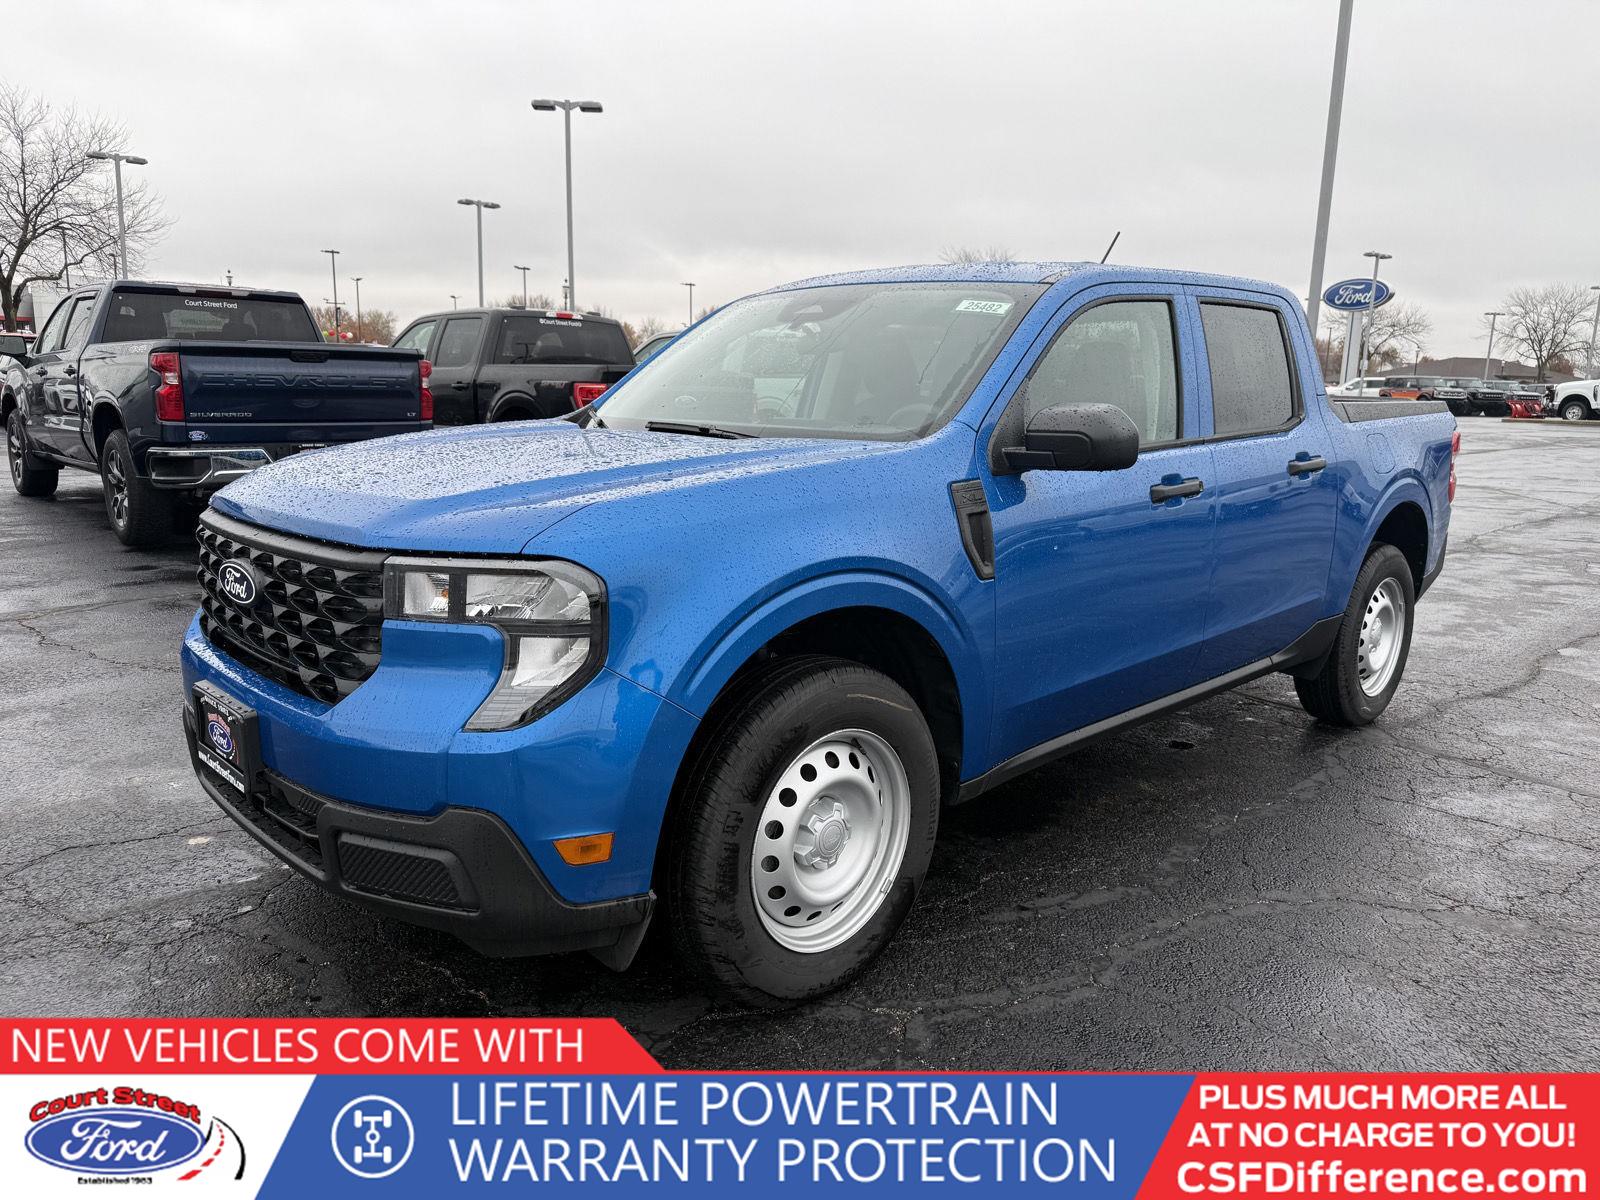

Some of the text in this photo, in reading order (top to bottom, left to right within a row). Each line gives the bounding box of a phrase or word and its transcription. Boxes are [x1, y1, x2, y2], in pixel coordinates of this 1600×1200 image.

[184, 299, 203, 307] Court
[203, 300, 223, 308] Street
[1334, 284, 1373, 305] Ford
[964, 301, 1002, 312] 25482
[202, 372, 408, 389] CHEVROLET
[225, 568, 248, 599] Ford
[213, 725, 228, 748] Ford
